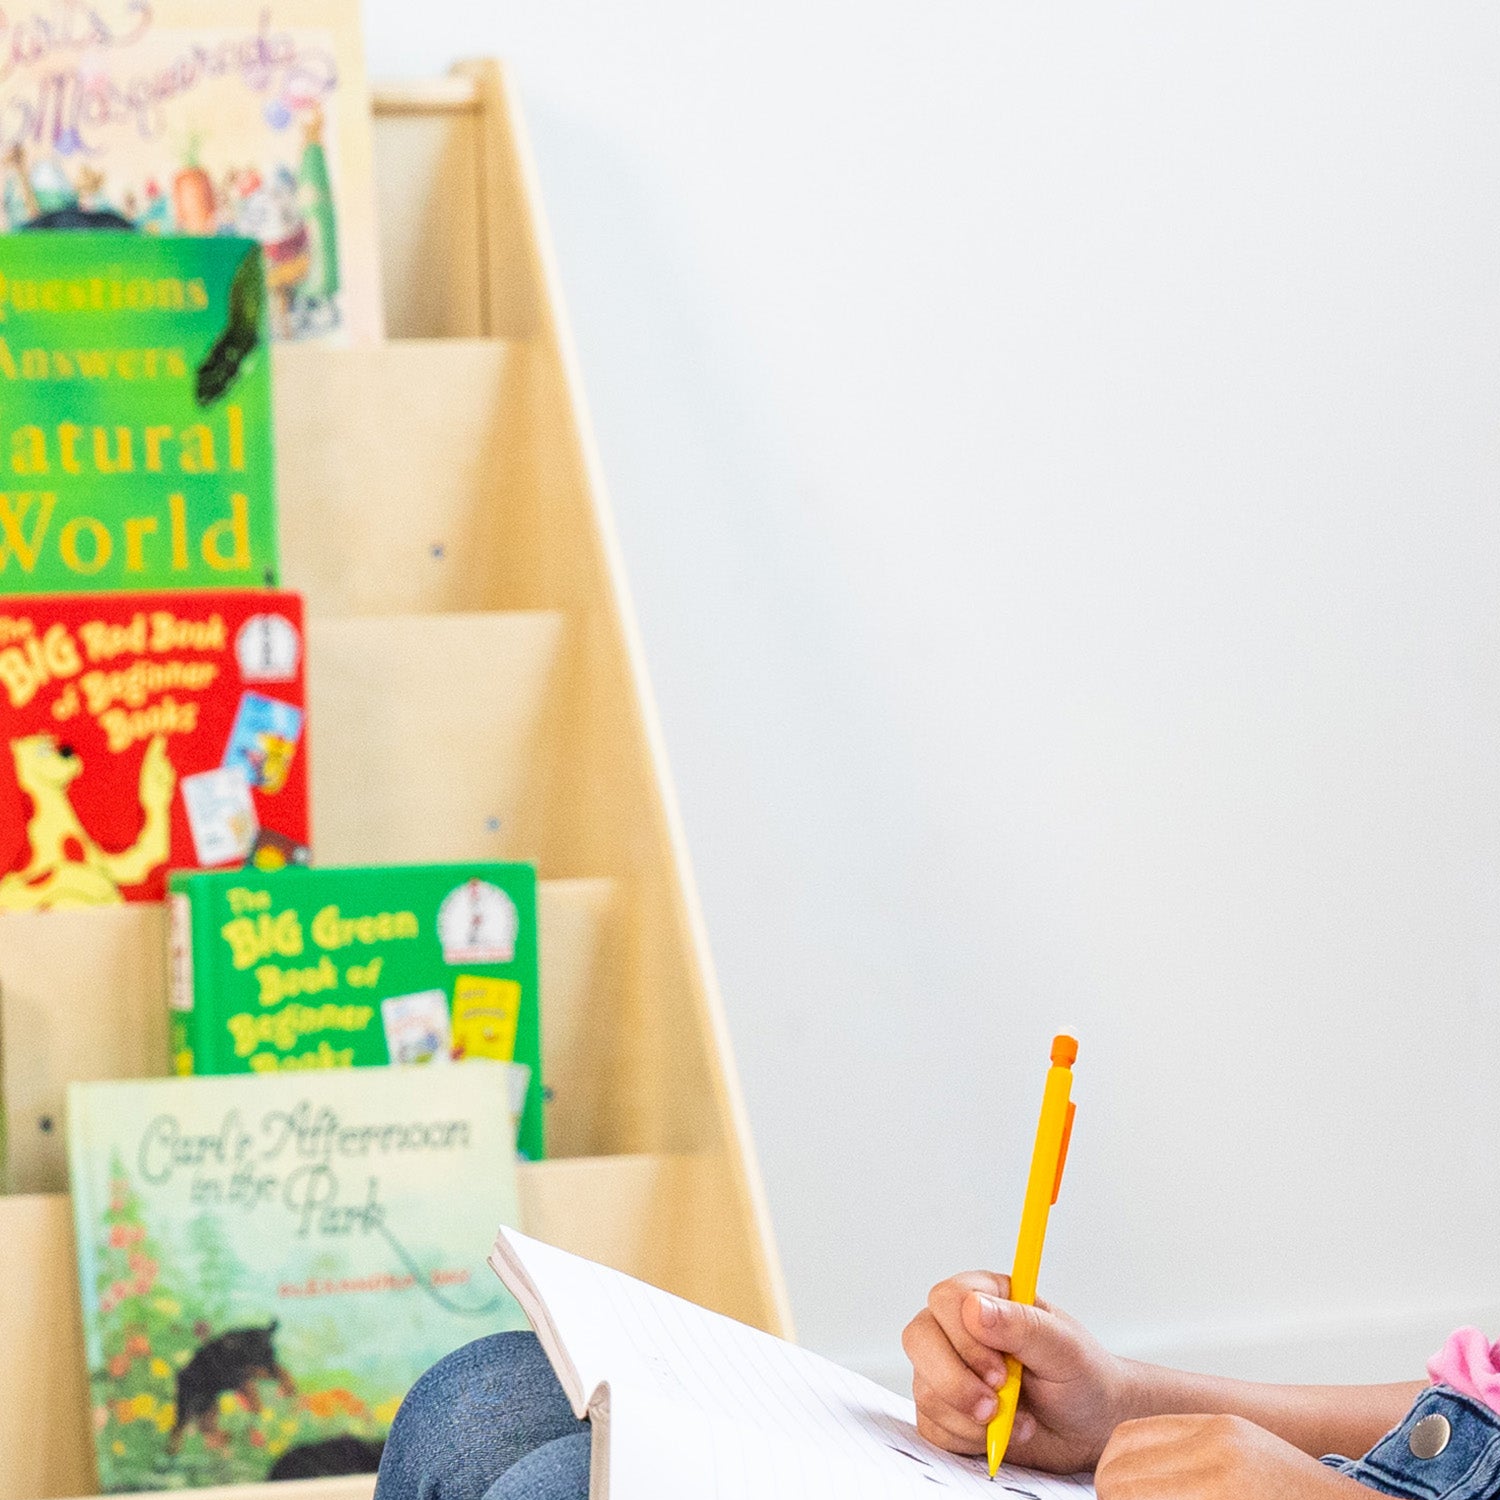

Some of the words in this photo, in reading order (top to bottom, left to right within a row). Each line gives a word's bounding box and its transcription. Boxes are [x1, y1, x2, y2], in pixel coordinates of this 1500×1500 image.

[0, 265, 208, 324] uestions
[10, 404, 246, 475] atural
[227, 887, 271, 914] The
[221, 908, 304, 970] BIG
[310, 904, 420, 950] Green
[255, 955, 338, 1006] Book
[345, 956, 384, 988] of
[226, 1003, 374, 1057] Beginner
